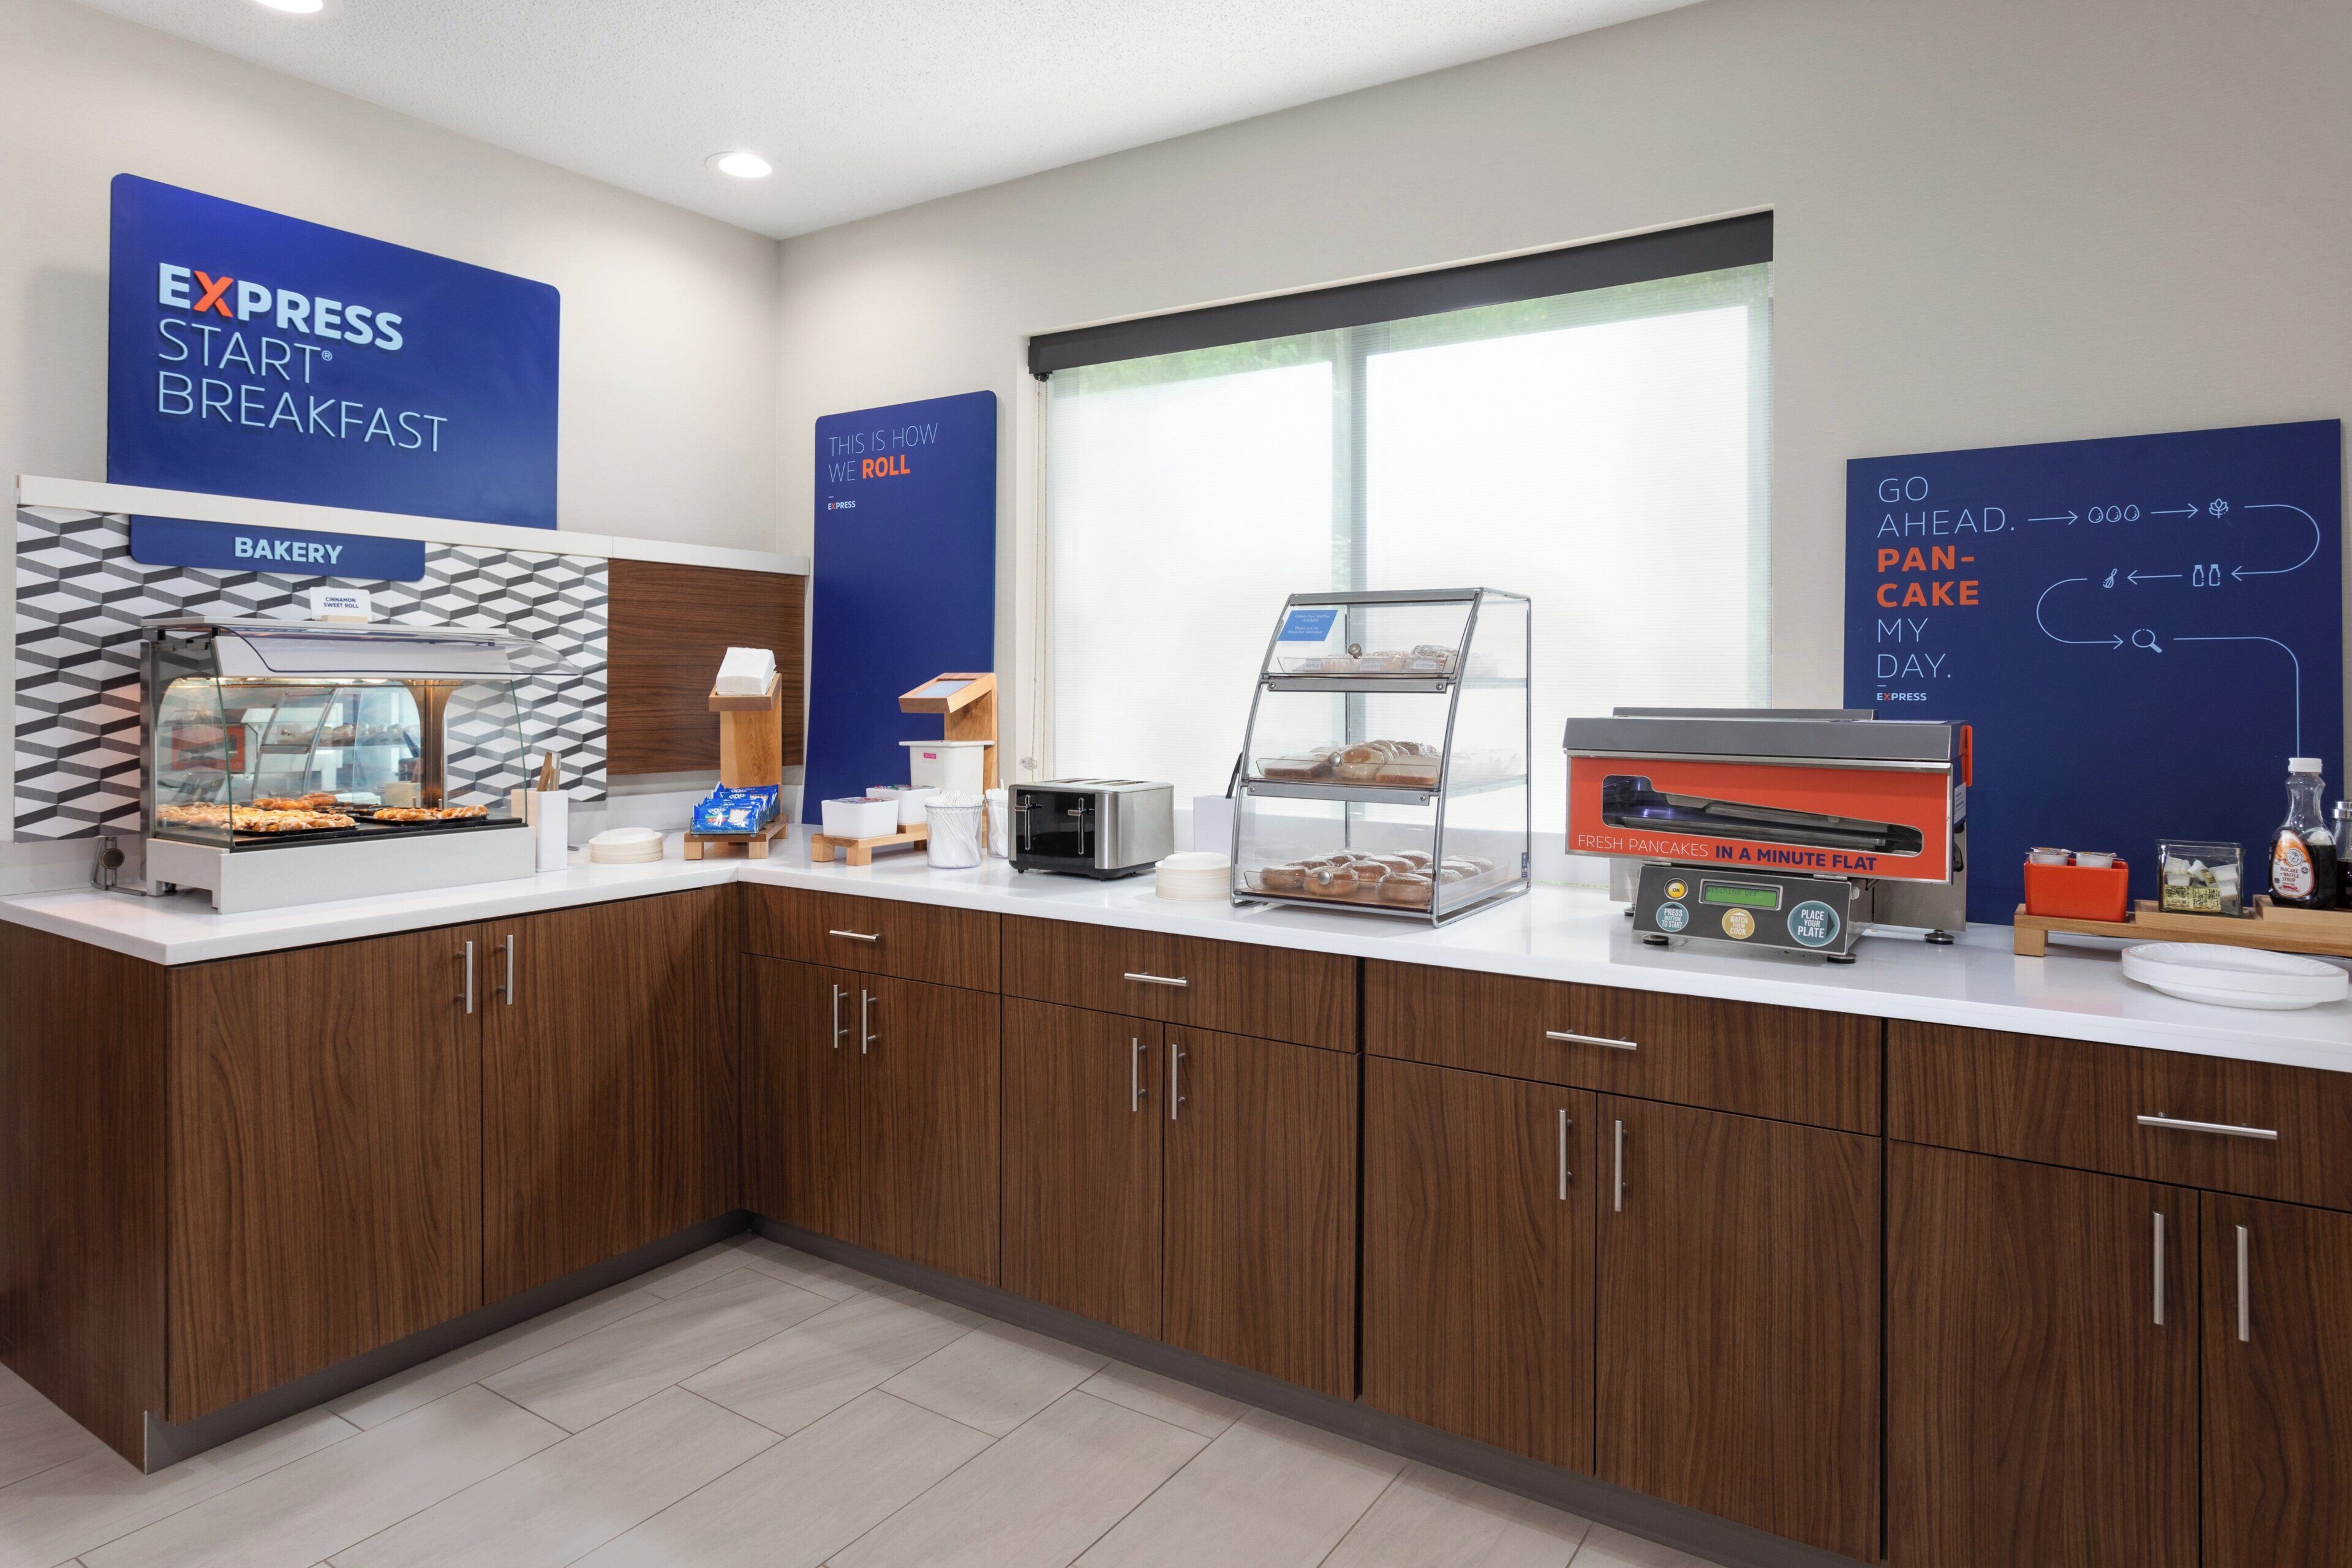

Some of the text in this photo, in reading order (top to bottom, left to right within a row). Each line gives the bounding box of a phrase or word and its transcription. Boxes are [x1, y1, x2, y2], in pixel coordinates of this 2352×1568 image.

[159, 263, 403, 351] EXPRESS
[159, 371, 448, 452] BREAKFAST
[829, 423, 938, 456] THIS IS HOW
[829, 454, 910, 483] WE ROLL
[1879, 476, 1928, 502] GO
[827, 500, 856, 510] EXPRESS
[1877, 507, 2014, 538] AHEAD.
[235, 537, 342, 564] BAKERY
[1878, 545, 1975, 573] PAN-
[1877, 580, 1978, 608] CAKE
[1878, 617, 1929, 643] MY
[1877, 654, 1951, 678] DAY.
[1578, 834, 1877, 870] FRESH PANCAKES IN A MINUTE FLAT
[1801, 909, 1825, 921] PLACE
[1797, 926, 1825, 938] PLATE
